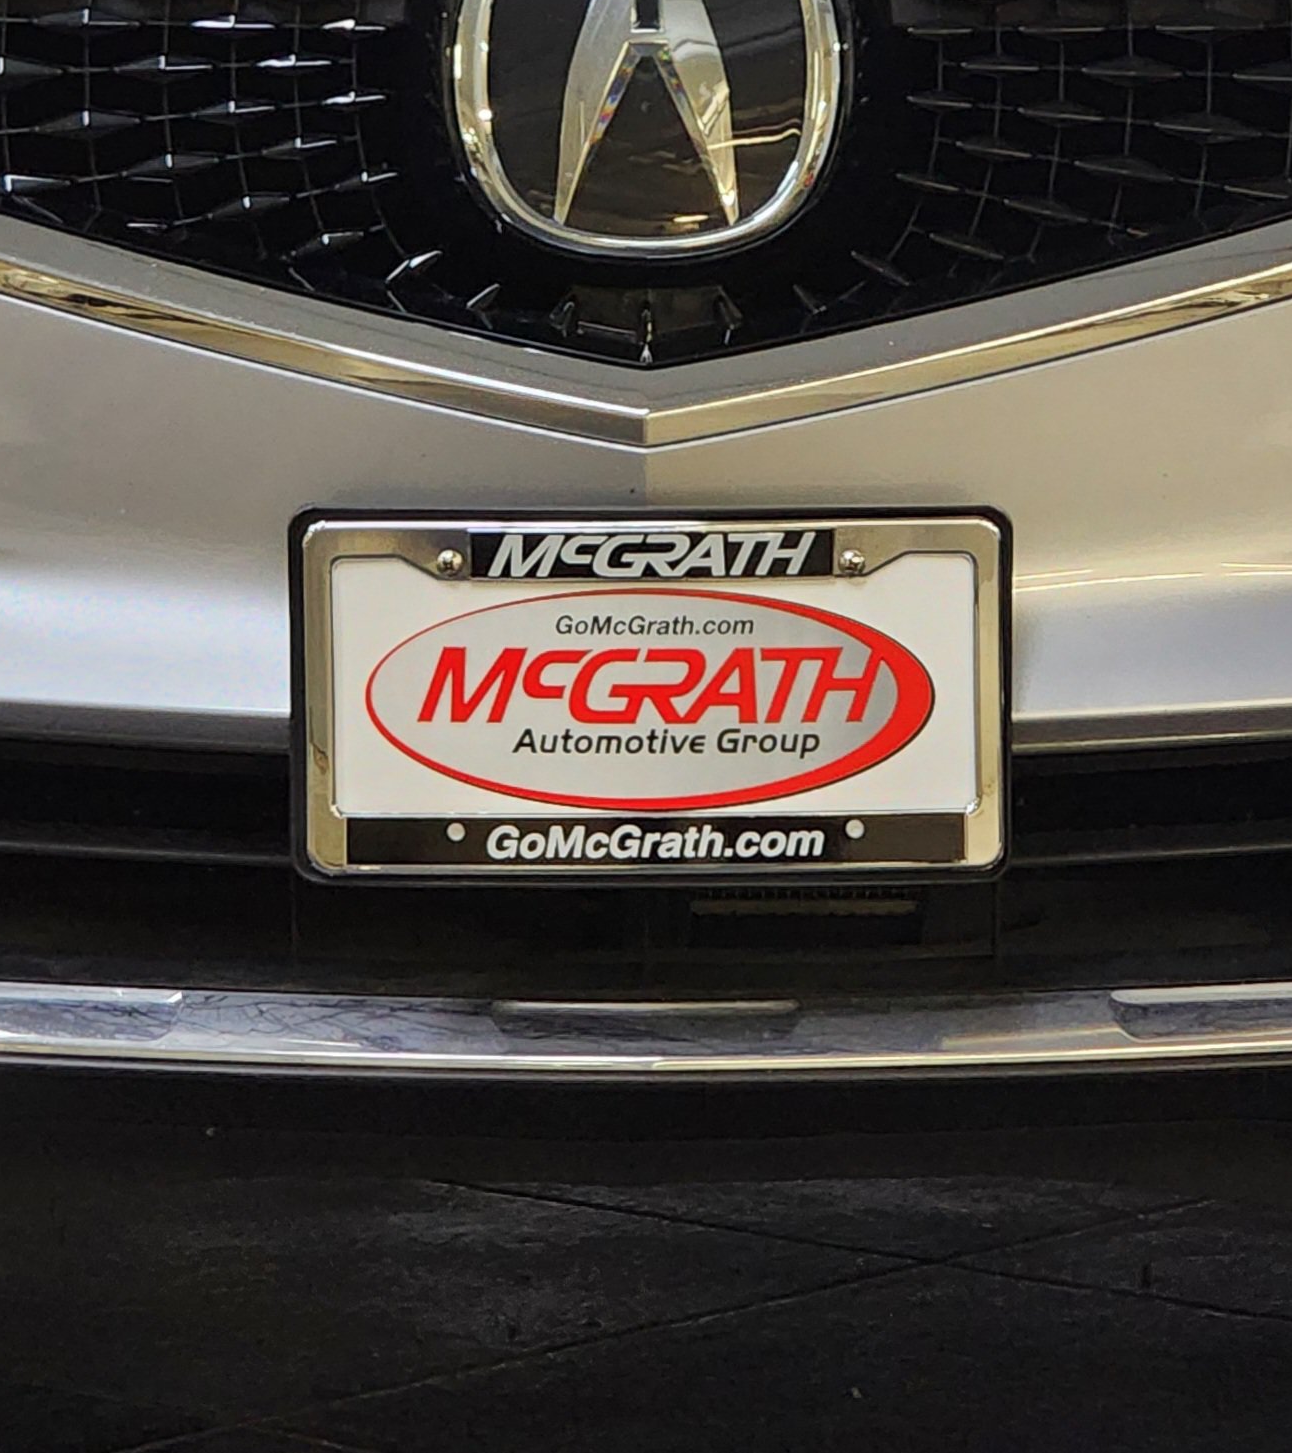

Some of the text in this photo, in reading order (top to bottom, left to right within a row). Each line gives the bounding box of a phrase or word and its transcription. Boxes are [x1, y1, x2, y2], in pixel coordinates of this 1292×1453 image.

[555, 614, 755, 637] GoMcGrath.com
[512, 729, 821, 759] Automotive Group
[486, 825, 825, 860] GoMcGrath.com
